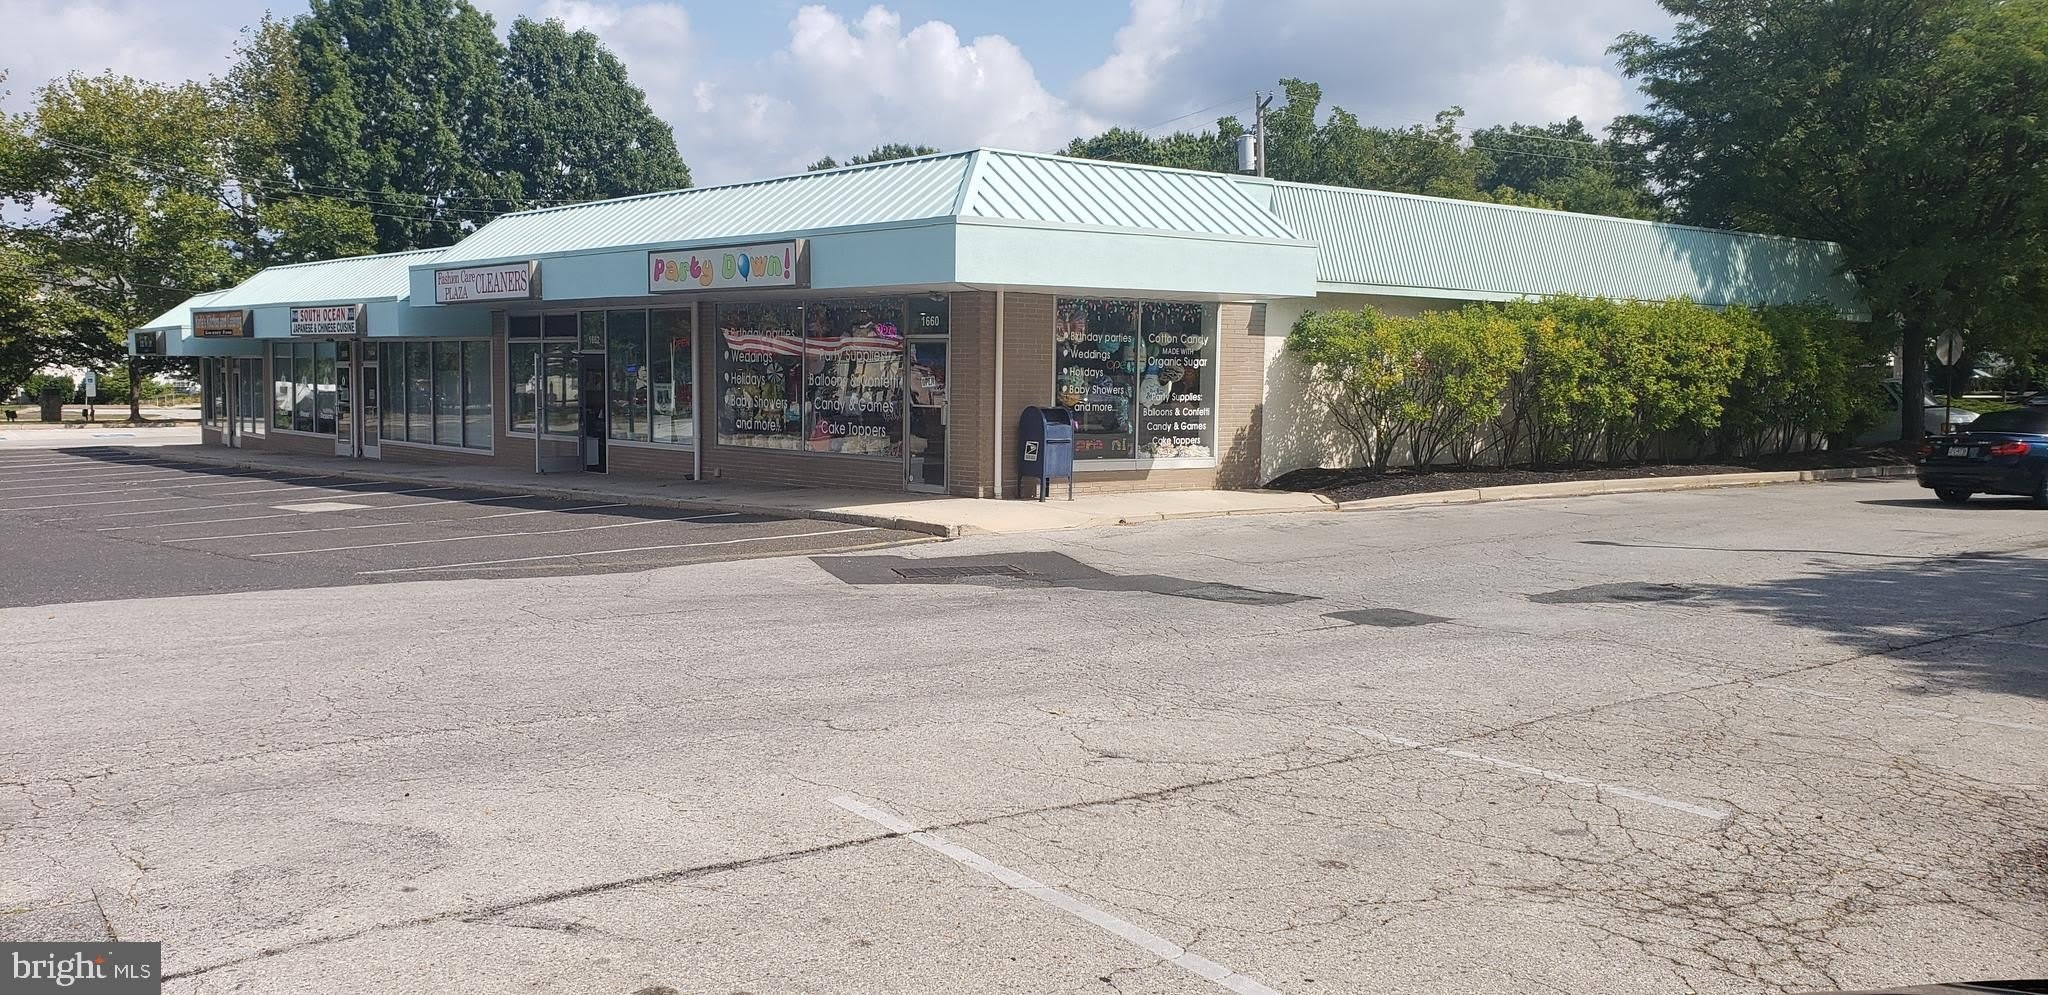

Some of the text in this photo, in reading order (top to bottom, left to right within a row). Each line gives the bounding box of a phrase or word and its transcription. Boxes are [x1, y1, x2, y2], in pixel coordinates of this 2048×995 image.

[653, 255, 714, 286] Party
[438, 270, 476, 285] Fashion Care
[475, 269, 528, 294] CLEANERS
[444, 286, 469, 300] PLAZA
[300, 307, 346, 322] SOUTH OCEAN
[921, 315, 940, 327] 1660
[292, 321, 355, 333] JAPANESE & CHINESE CUISINE
[1070, 331, 1132, 344] Birthday parties
[1148, 333, 1209, 346] Cotton Candy
[731, 349, 773, 366] Weddings
[1070, 349, 1111, 362] Weddings
[1162, 347, 1180, 355] MADE
[1147, 356, 1208, 369] Organic Sugar
[730, 371, 766, 386] Holidays
[1069, 367, 1104, 379] Holidays
[808, 373, 848, 388] Balloons
[1069, 384, 1125, 396] Baby Showers
[731, 394, 788, 410] Baby Showers
[1151, 392, 1170, 403] Party
[814, 396, 894, 414] Candy & Games
[1074, 402, 1091, 412] and
[1142, 407, 1211, 417] Balloons & Confetti
[735, 417, 753, 430] and
[820, 420, 887, 438] Cake Toppers
[1146, 421, 1207, 432] Candy & Games
[1152, 436, 1201, 445] Cake Toppers
